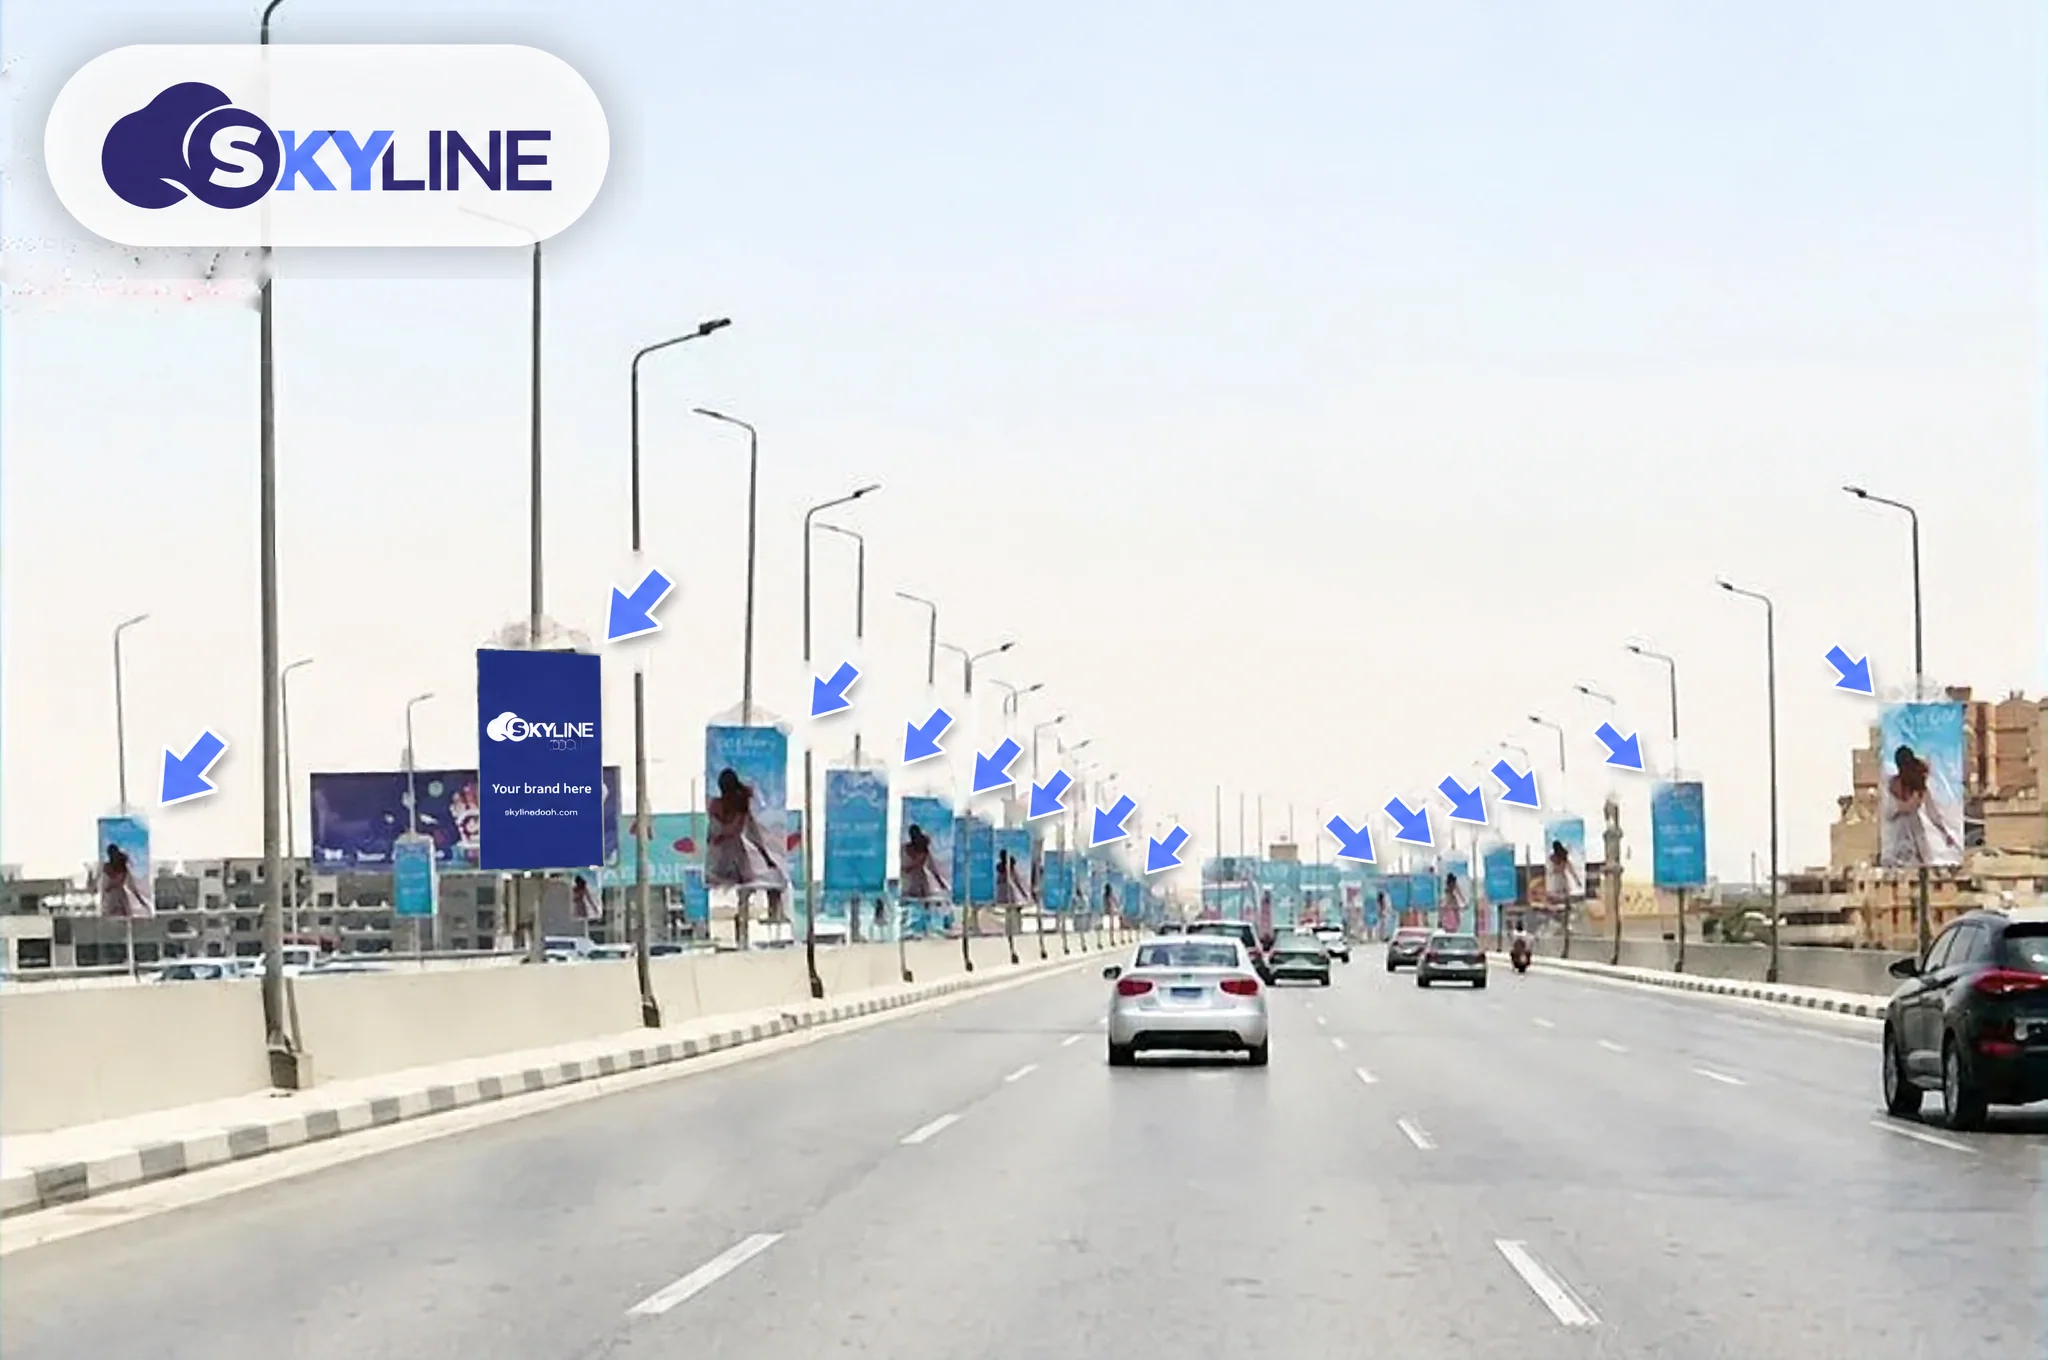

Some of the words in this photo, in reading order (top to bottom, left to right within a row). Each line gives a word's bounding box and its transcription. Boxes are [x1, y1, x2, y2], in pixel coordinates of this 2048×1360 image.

[512, 721, 594, 738] SKYLINE
[492, 783, 521, 795] Your
[524, 782, 560, 795] brand
[563, 782, 592, 795] here
[504, 808, 578, 817] skylinedooh.com
